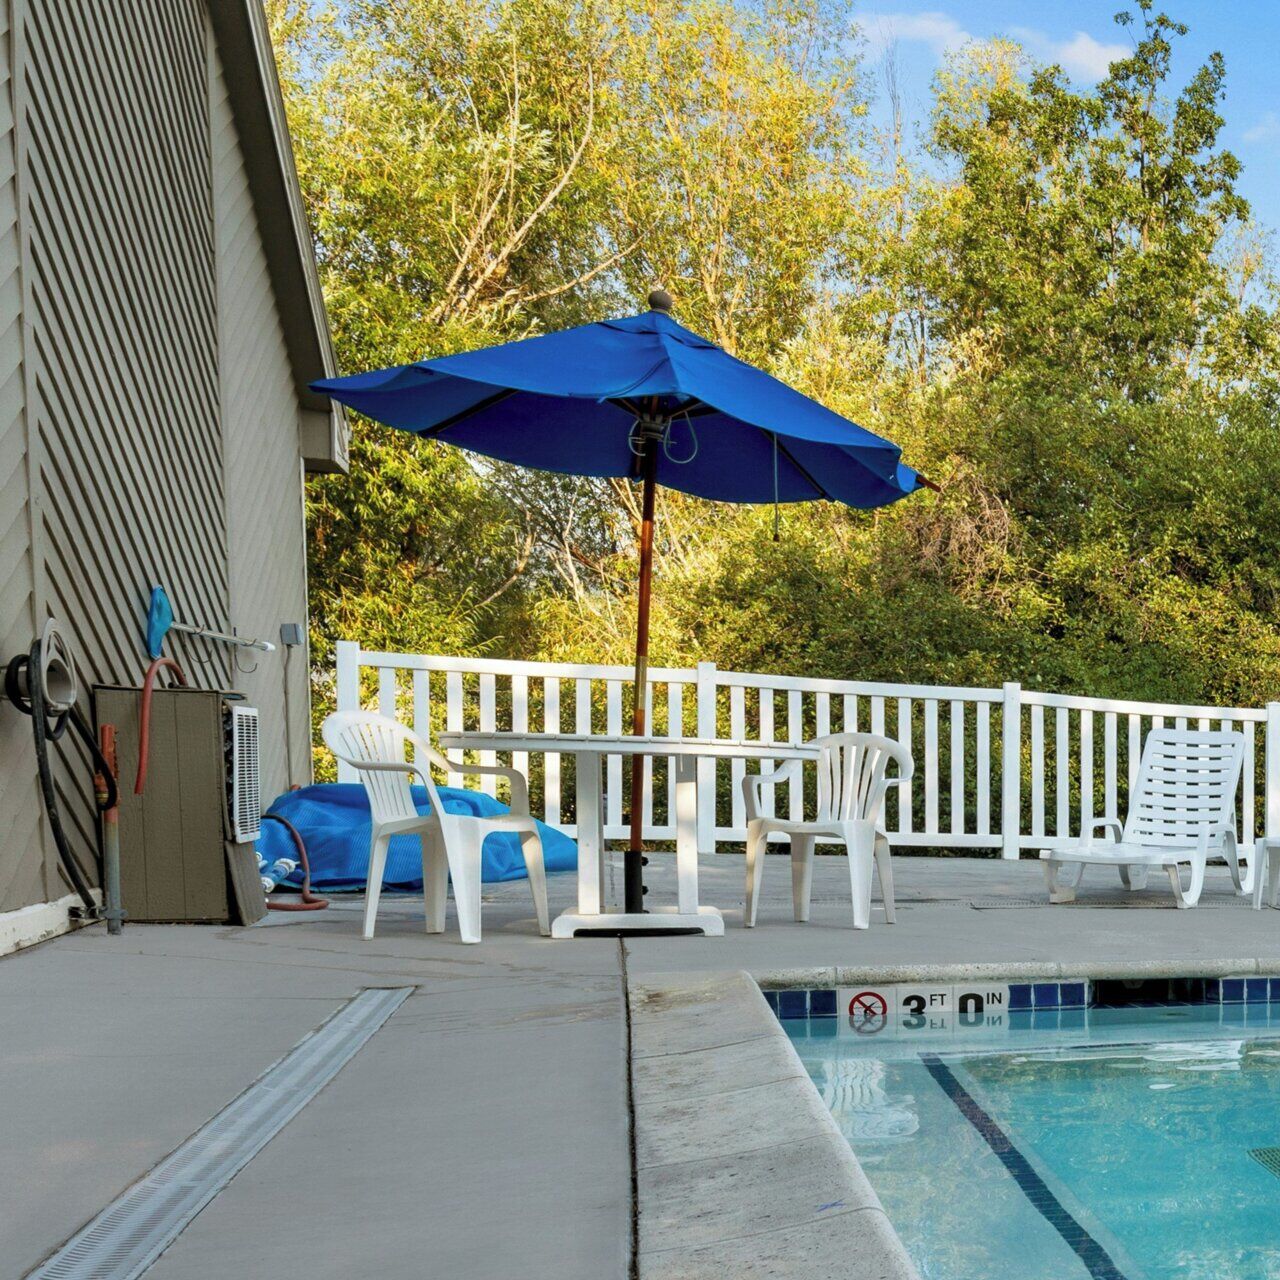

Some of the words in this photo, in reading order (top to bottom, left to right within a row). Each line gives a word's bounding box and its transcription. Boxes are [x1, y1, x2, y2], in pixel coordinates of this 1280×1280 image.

[903, 994, 927, 1015] 3
[930, 993, 947, 1006] FT
[958, 993, 984, 1013] 0
[986, 992, 1002, 1005] IN
